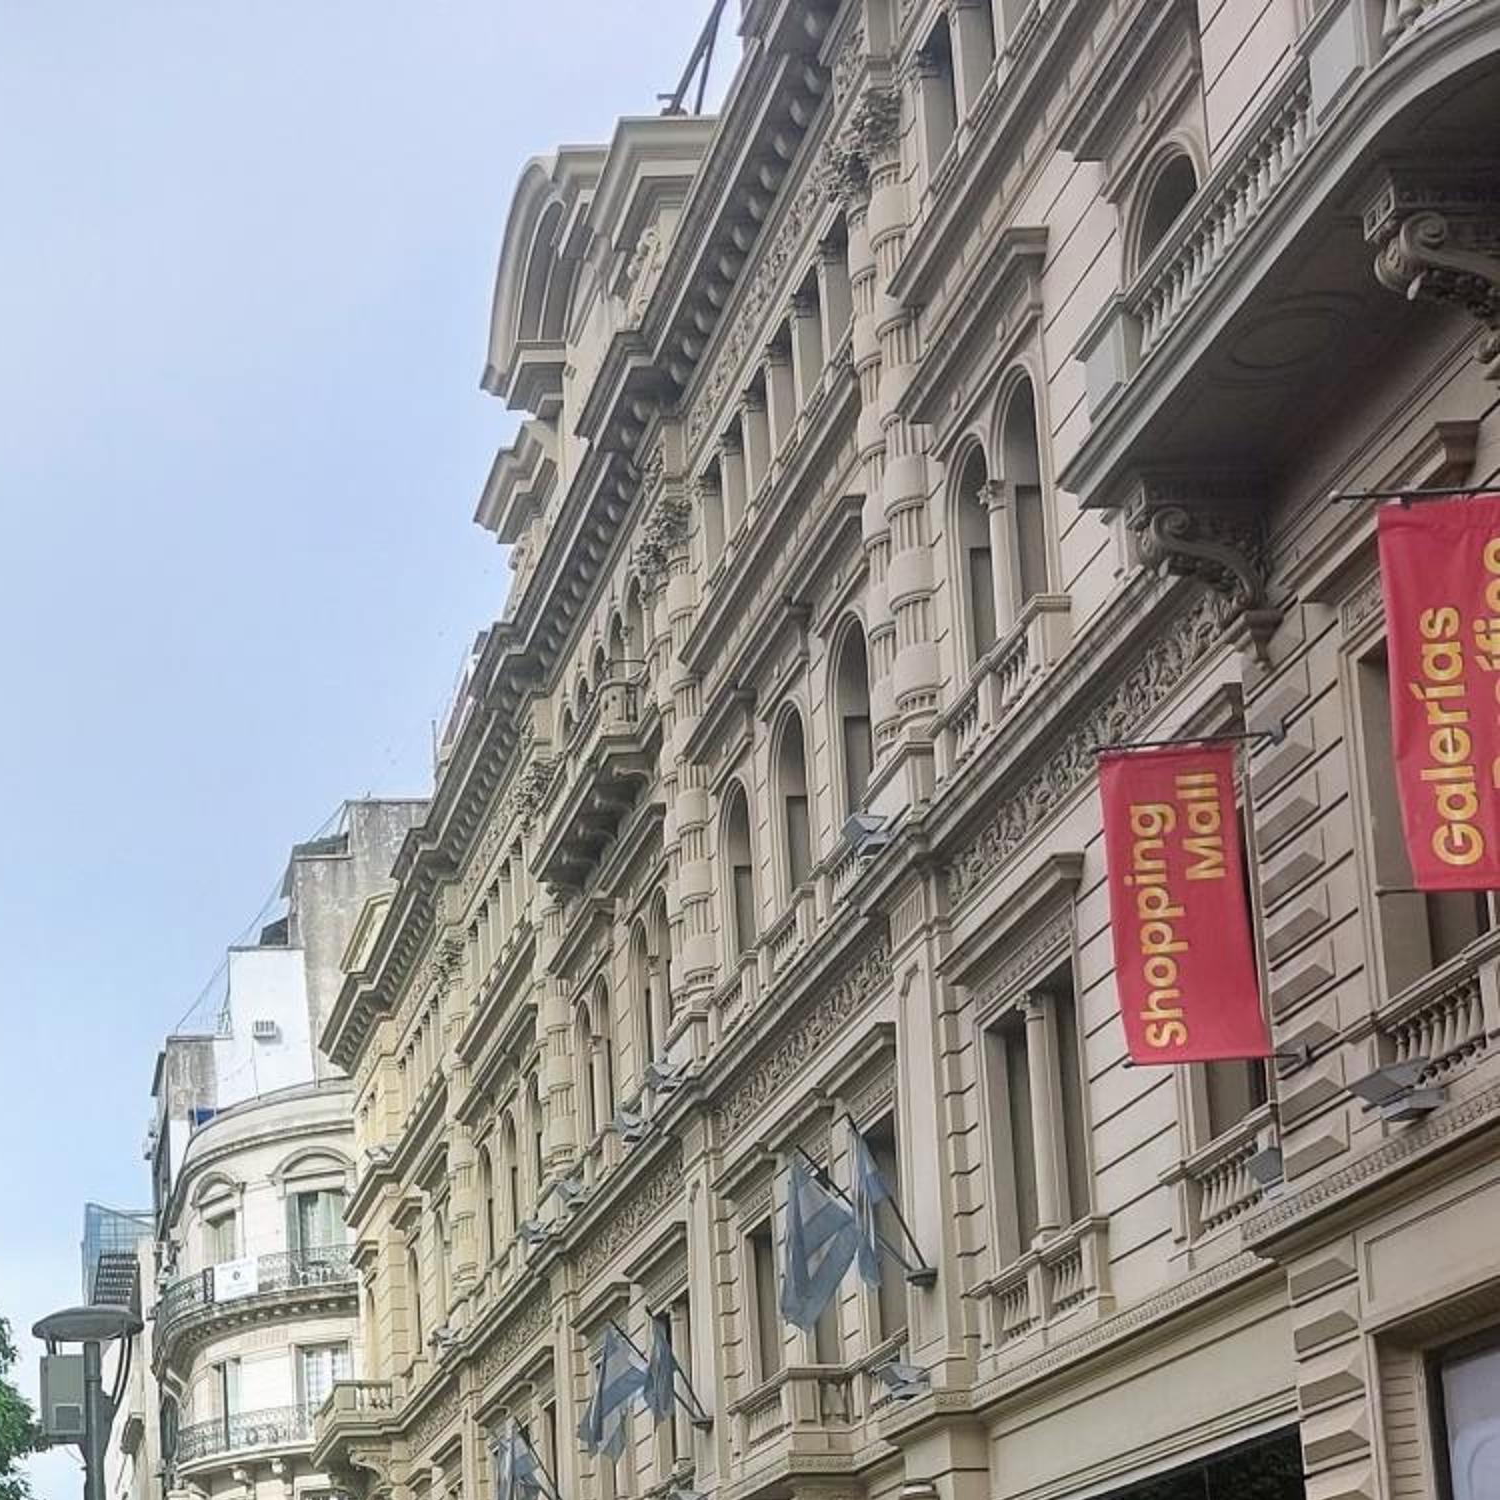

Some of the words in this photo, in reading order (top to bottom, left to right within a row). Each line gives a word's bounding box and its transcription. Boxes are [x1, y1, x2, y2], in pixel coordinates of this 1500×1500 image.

[1174, 772, 1226, 881] Mall
[1410, 606, 1485, 866] Galerías
[1123, 803, 1189, 1049] Shopping
